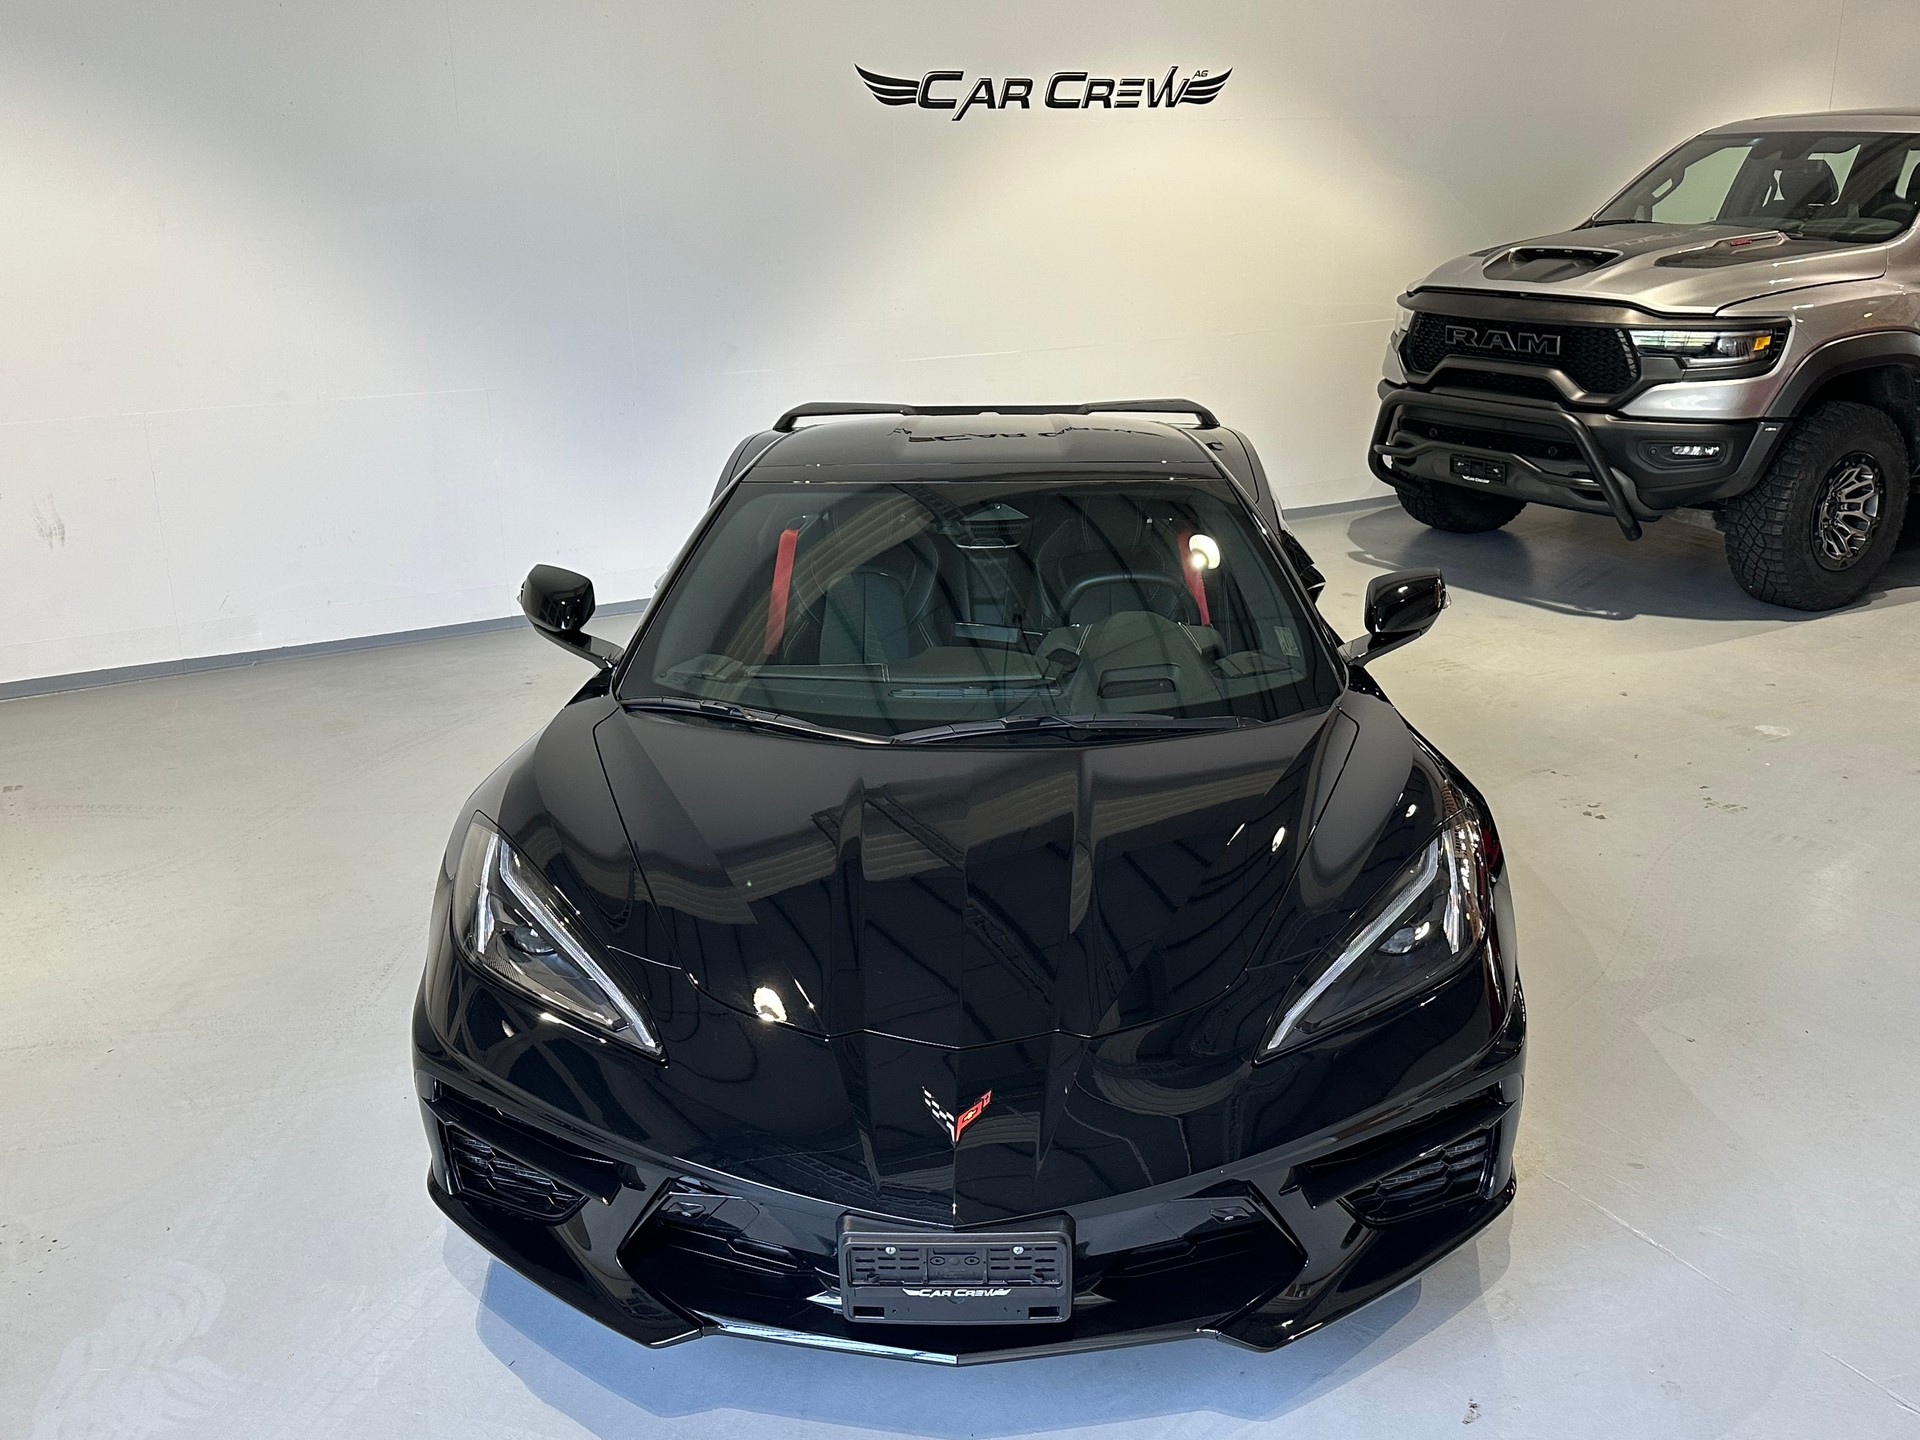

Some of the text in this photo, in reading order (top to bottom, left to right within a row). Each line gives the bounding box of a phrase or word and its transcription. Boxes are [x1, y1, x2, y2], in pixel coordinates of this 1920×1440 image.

[917, 65, 1209, 121] CAR CREW AG
[1444, 325, 1561, 355] RAM
[920, 1288, 995, 1298] CAR CREW
